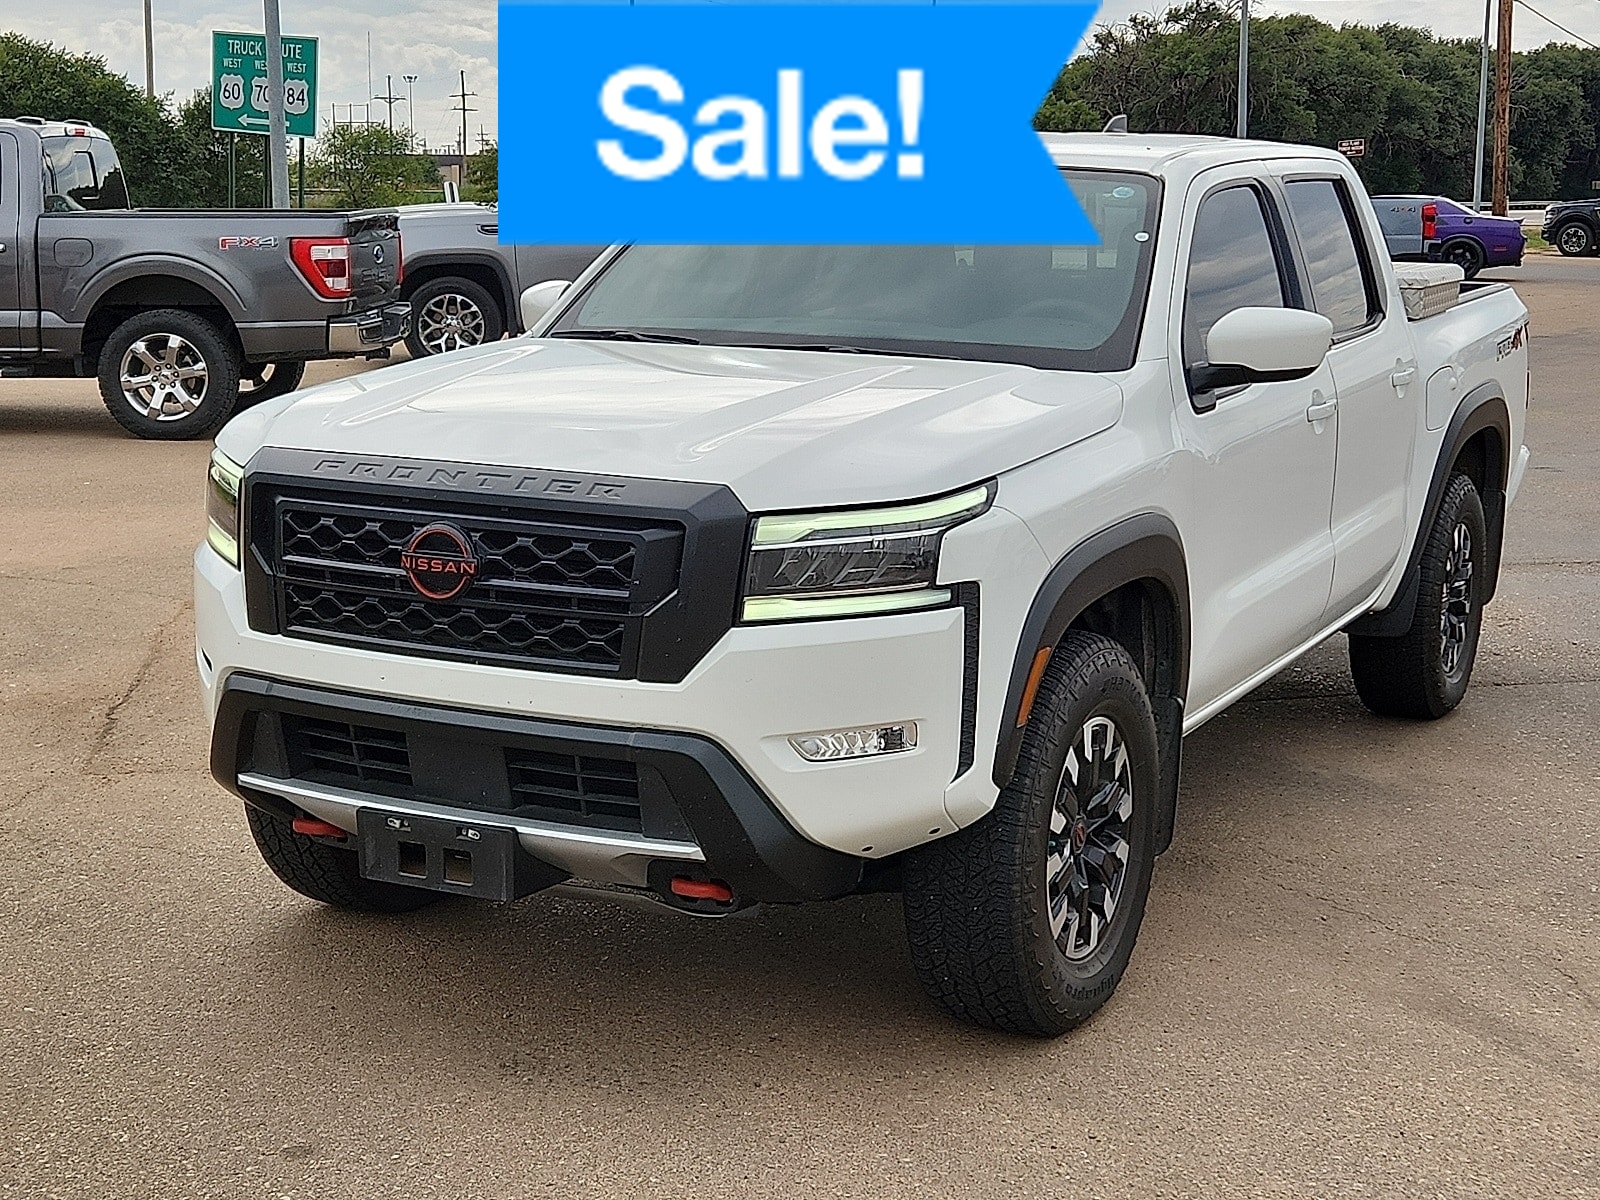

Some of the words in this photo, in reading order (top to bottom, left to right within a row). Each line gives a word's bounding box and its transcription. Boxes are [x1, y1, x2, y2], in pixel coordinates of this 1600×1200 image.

[228, 39, 262, 56] TRUCK
[281, 43, 302, 59] UTE
[223, 58, 242, 68] WEST
[287, 62, 307, 73] WEST
[223, 82, 240, 100] 60
[286, 87, 306, 106] 84
[219, 235, 279, 250] FX4
[312, 459, 627, 499] FRONTIER
[401, 555, 475, 574] NISSAN
